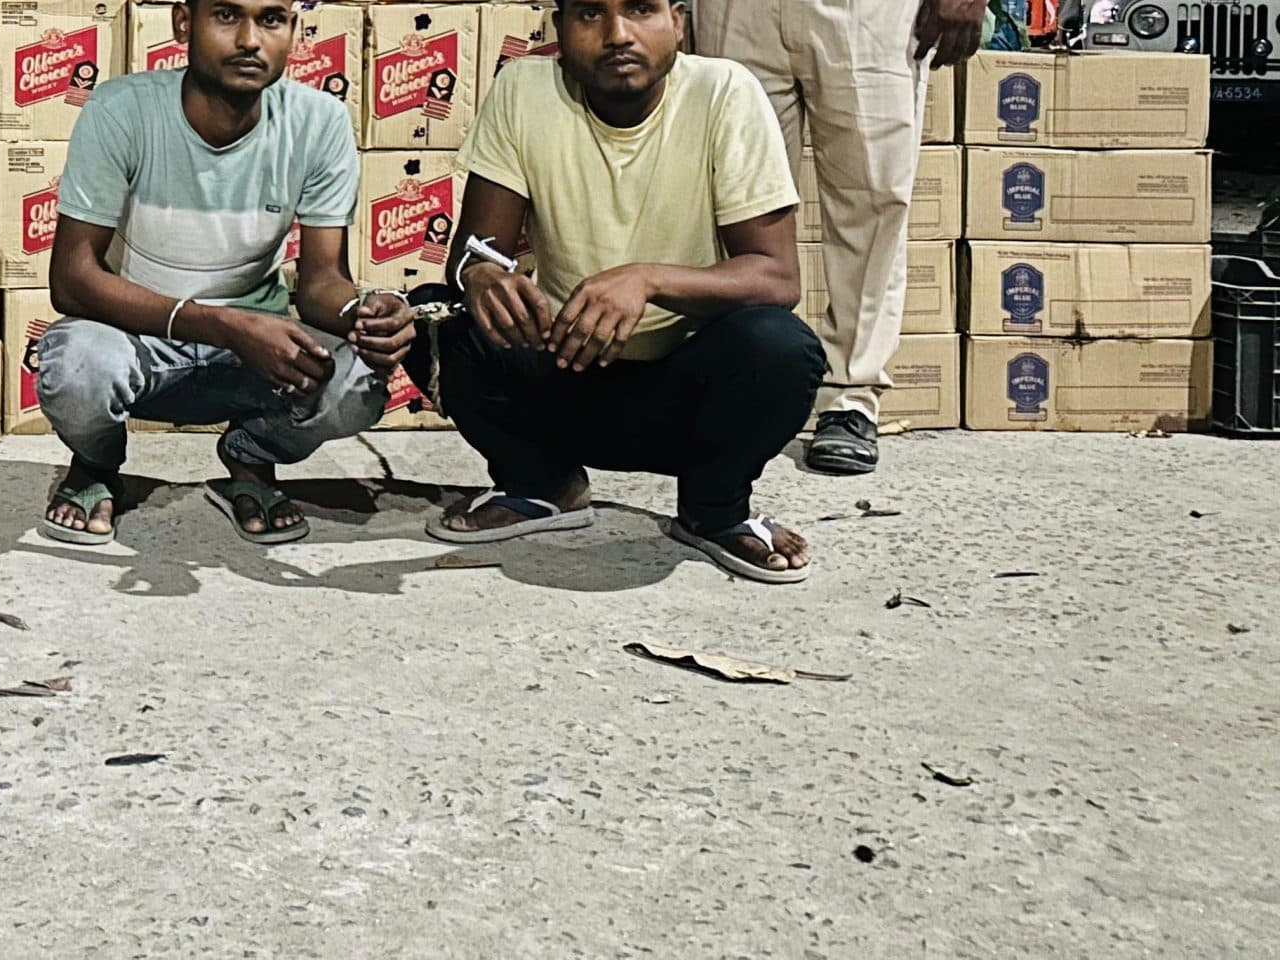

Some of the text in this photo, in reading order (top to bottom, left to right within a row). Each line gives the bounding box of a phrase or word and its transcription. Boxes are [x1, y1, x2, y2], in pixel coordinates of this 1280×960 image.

[22, 43, 86, 74] Officer's
[382, 50, 445, 83] Officer's
[19, 66, 68, 92] Choice
[379, 74, 428, 102] Choice
[378, 195, 442, 229] Officer's
[376, 220, 426, 247] Choice
